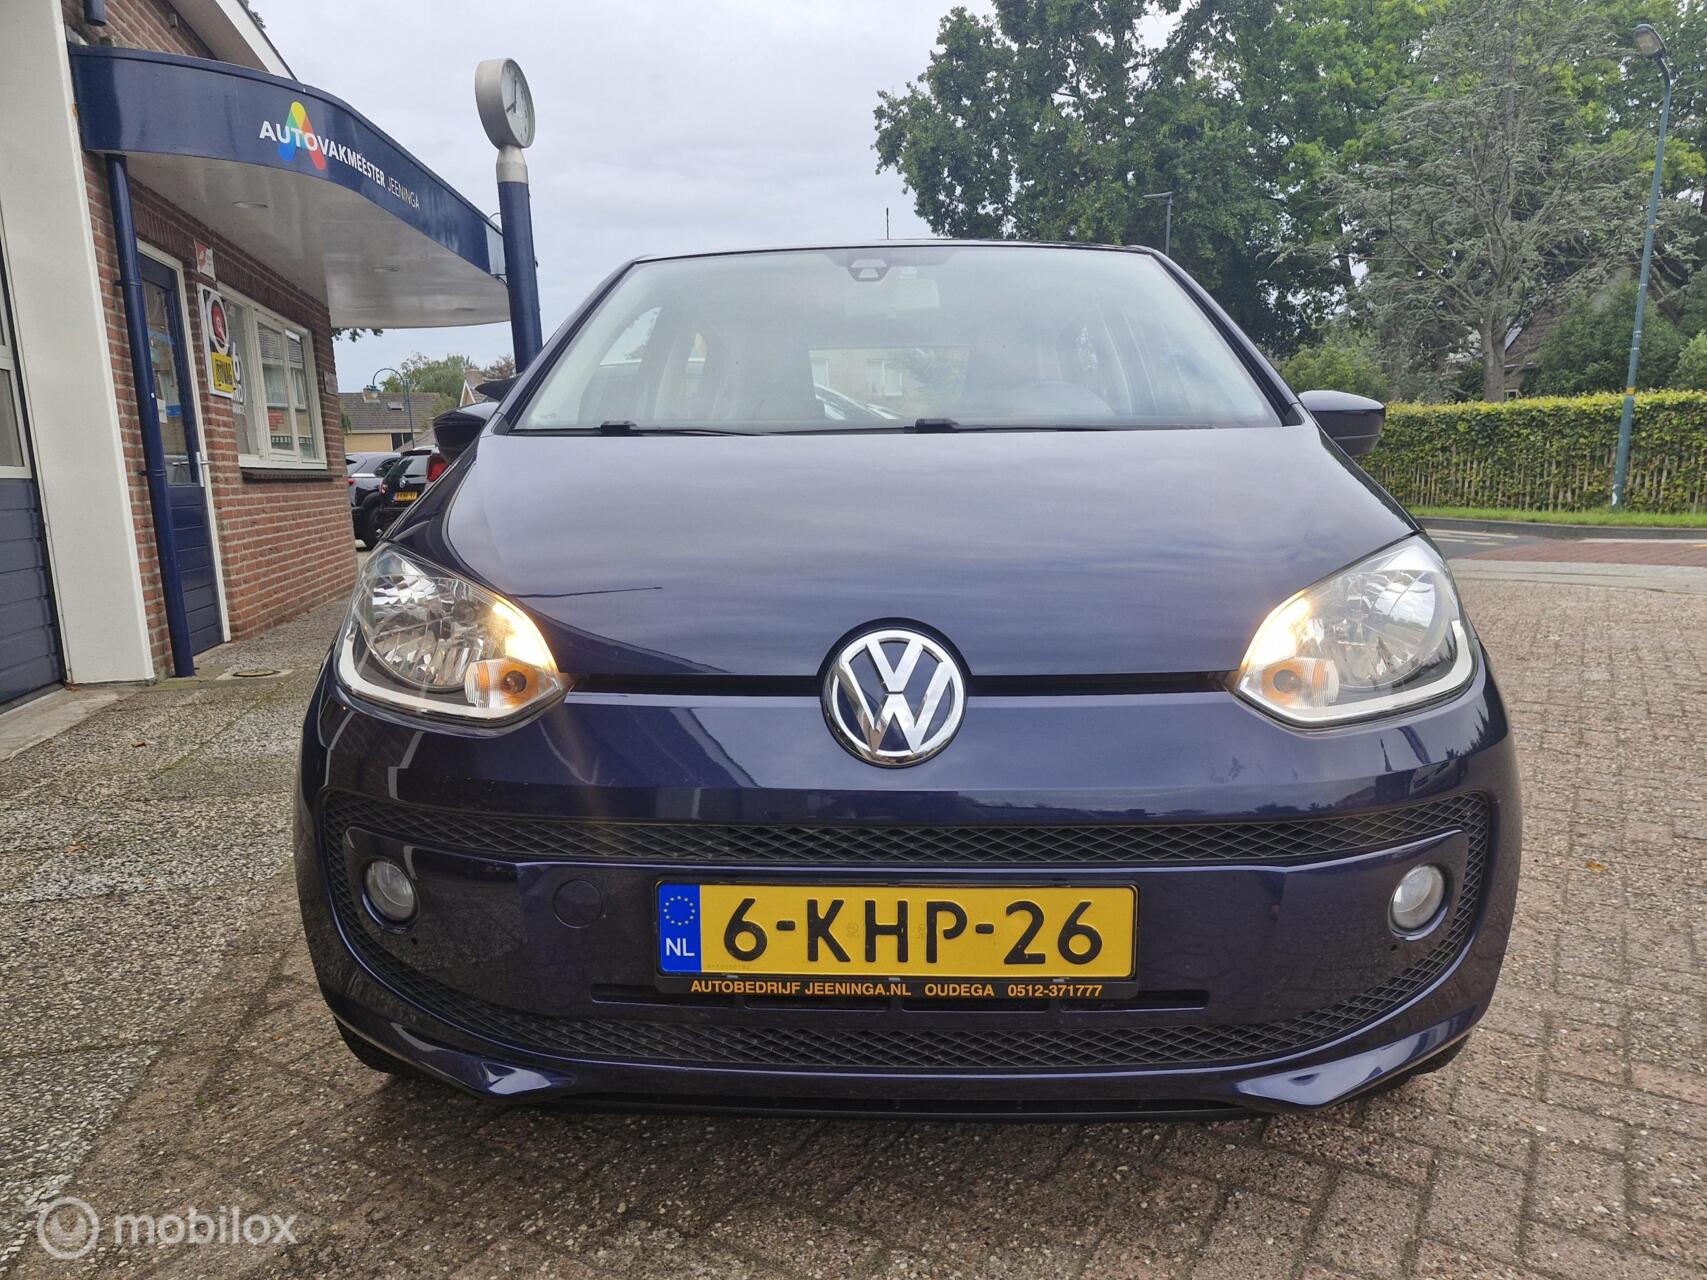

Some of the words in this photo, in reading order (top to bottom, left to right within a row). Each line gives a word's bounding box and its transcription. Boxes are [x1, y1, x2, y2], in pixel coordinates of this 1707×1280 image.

[259, 120, 385, 188] AUTOVAKMEESTER
[388, 176, 420, 209] JEENINGA
[831, 632, 960, 761] VW
[665, 938, 695, 957] NL
[723, 898, 1103, 965] 6-KHP-26
[690, 980, 800, 994] AUTOBEDRIJF
[805, 983, 911, 996] JEENINGA.NL
[925, 984, 994, 997] OUDEGA
[1007, 984, 1102, 997] 0512-371777
